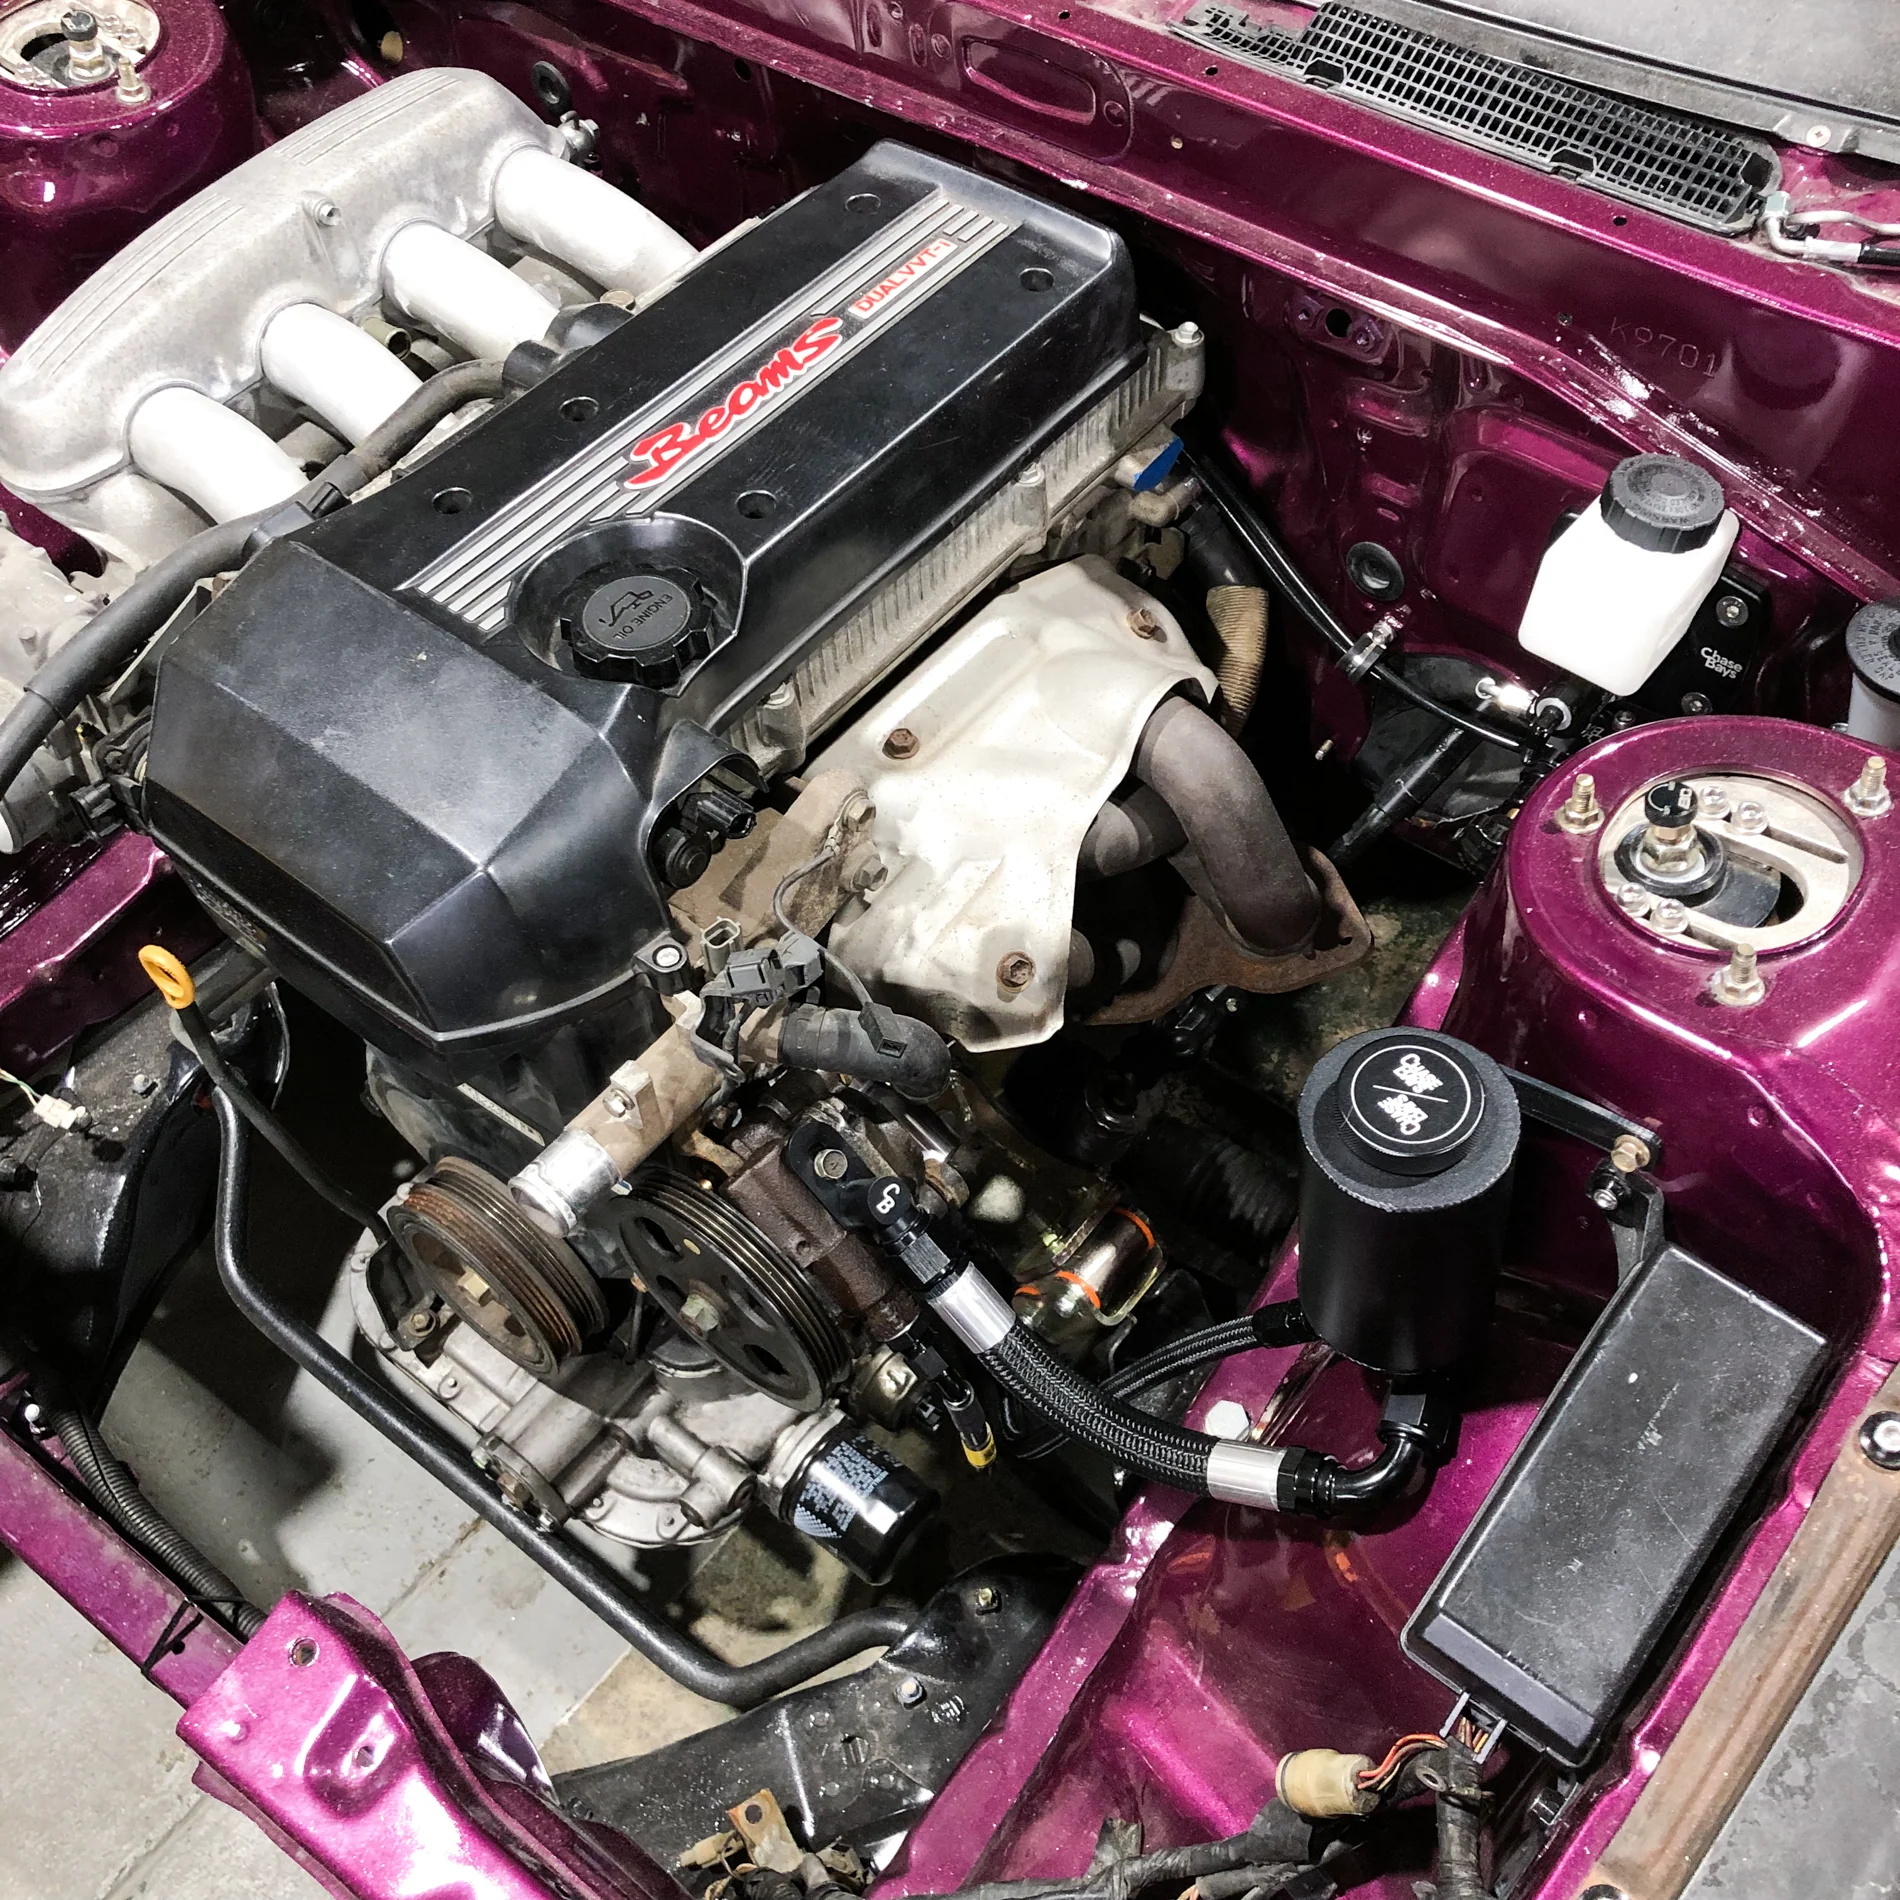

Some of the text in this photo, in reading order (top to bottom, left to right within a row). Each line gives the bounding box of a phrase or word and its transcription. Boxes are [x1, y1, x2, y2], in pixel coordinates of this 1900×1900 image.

[855, 278, 908, 312] DUAL
[624, 317, 843, 489] Beams
[613, 593, 673, 640] ENGINE OIL
[1701, 647, 1742, 672] Chase
[1705, 656, 1737, 679] Bays
